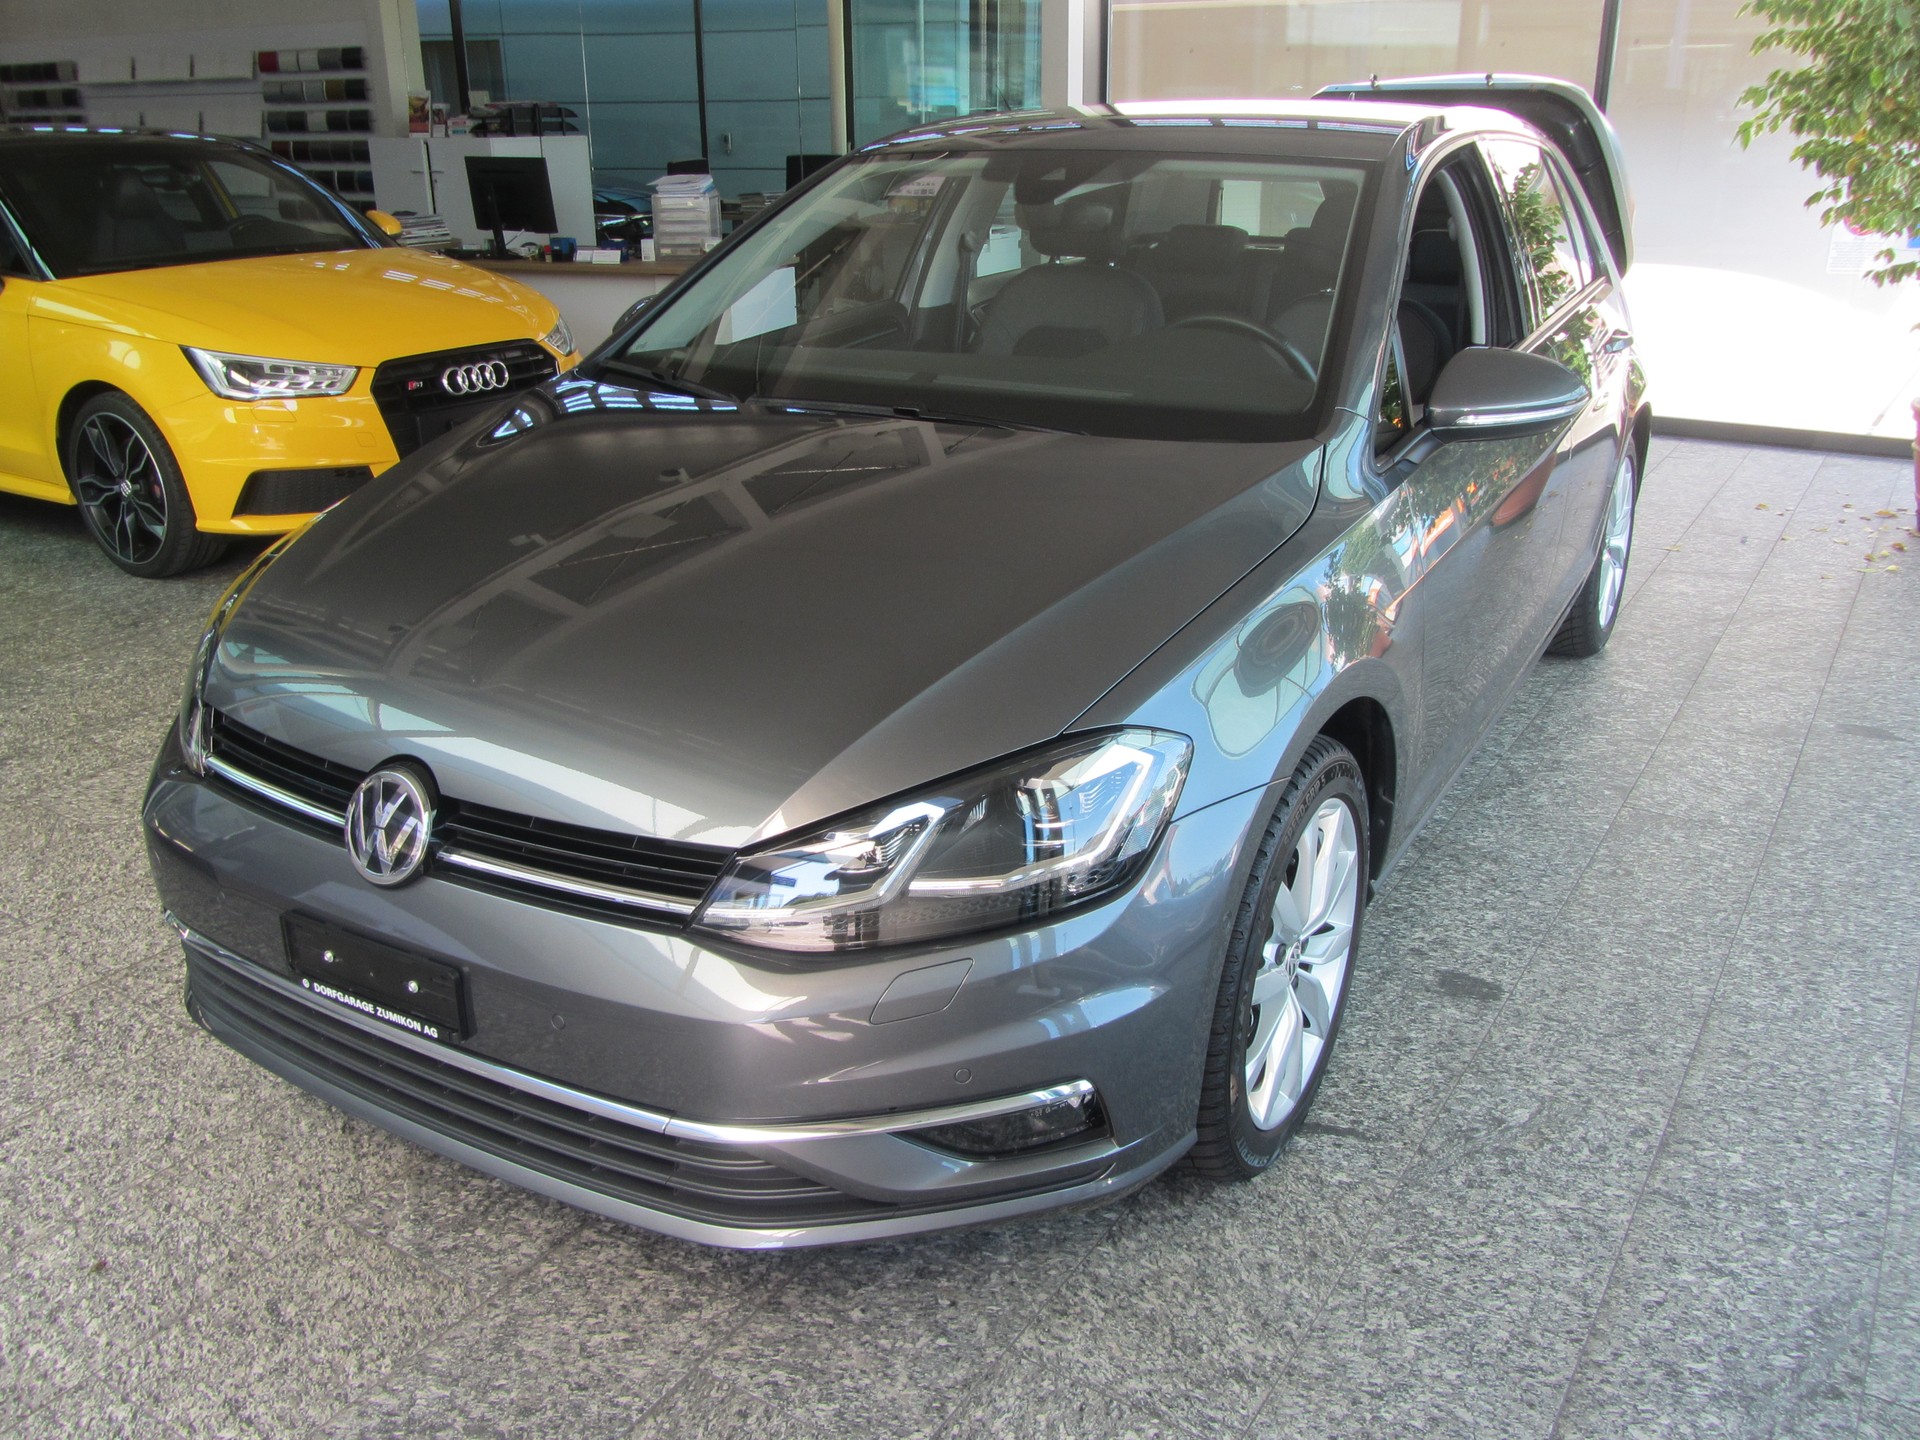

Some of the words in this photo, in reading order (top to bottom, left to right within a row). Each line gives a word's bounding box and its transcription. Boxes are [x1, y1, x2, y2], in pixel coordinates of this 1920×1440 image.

[313, 982, 375, 1014] DORFGARAGE
[376, 1006, 421, 1032] ZUMIKON
[424, 1024, 438, 1039] AG
